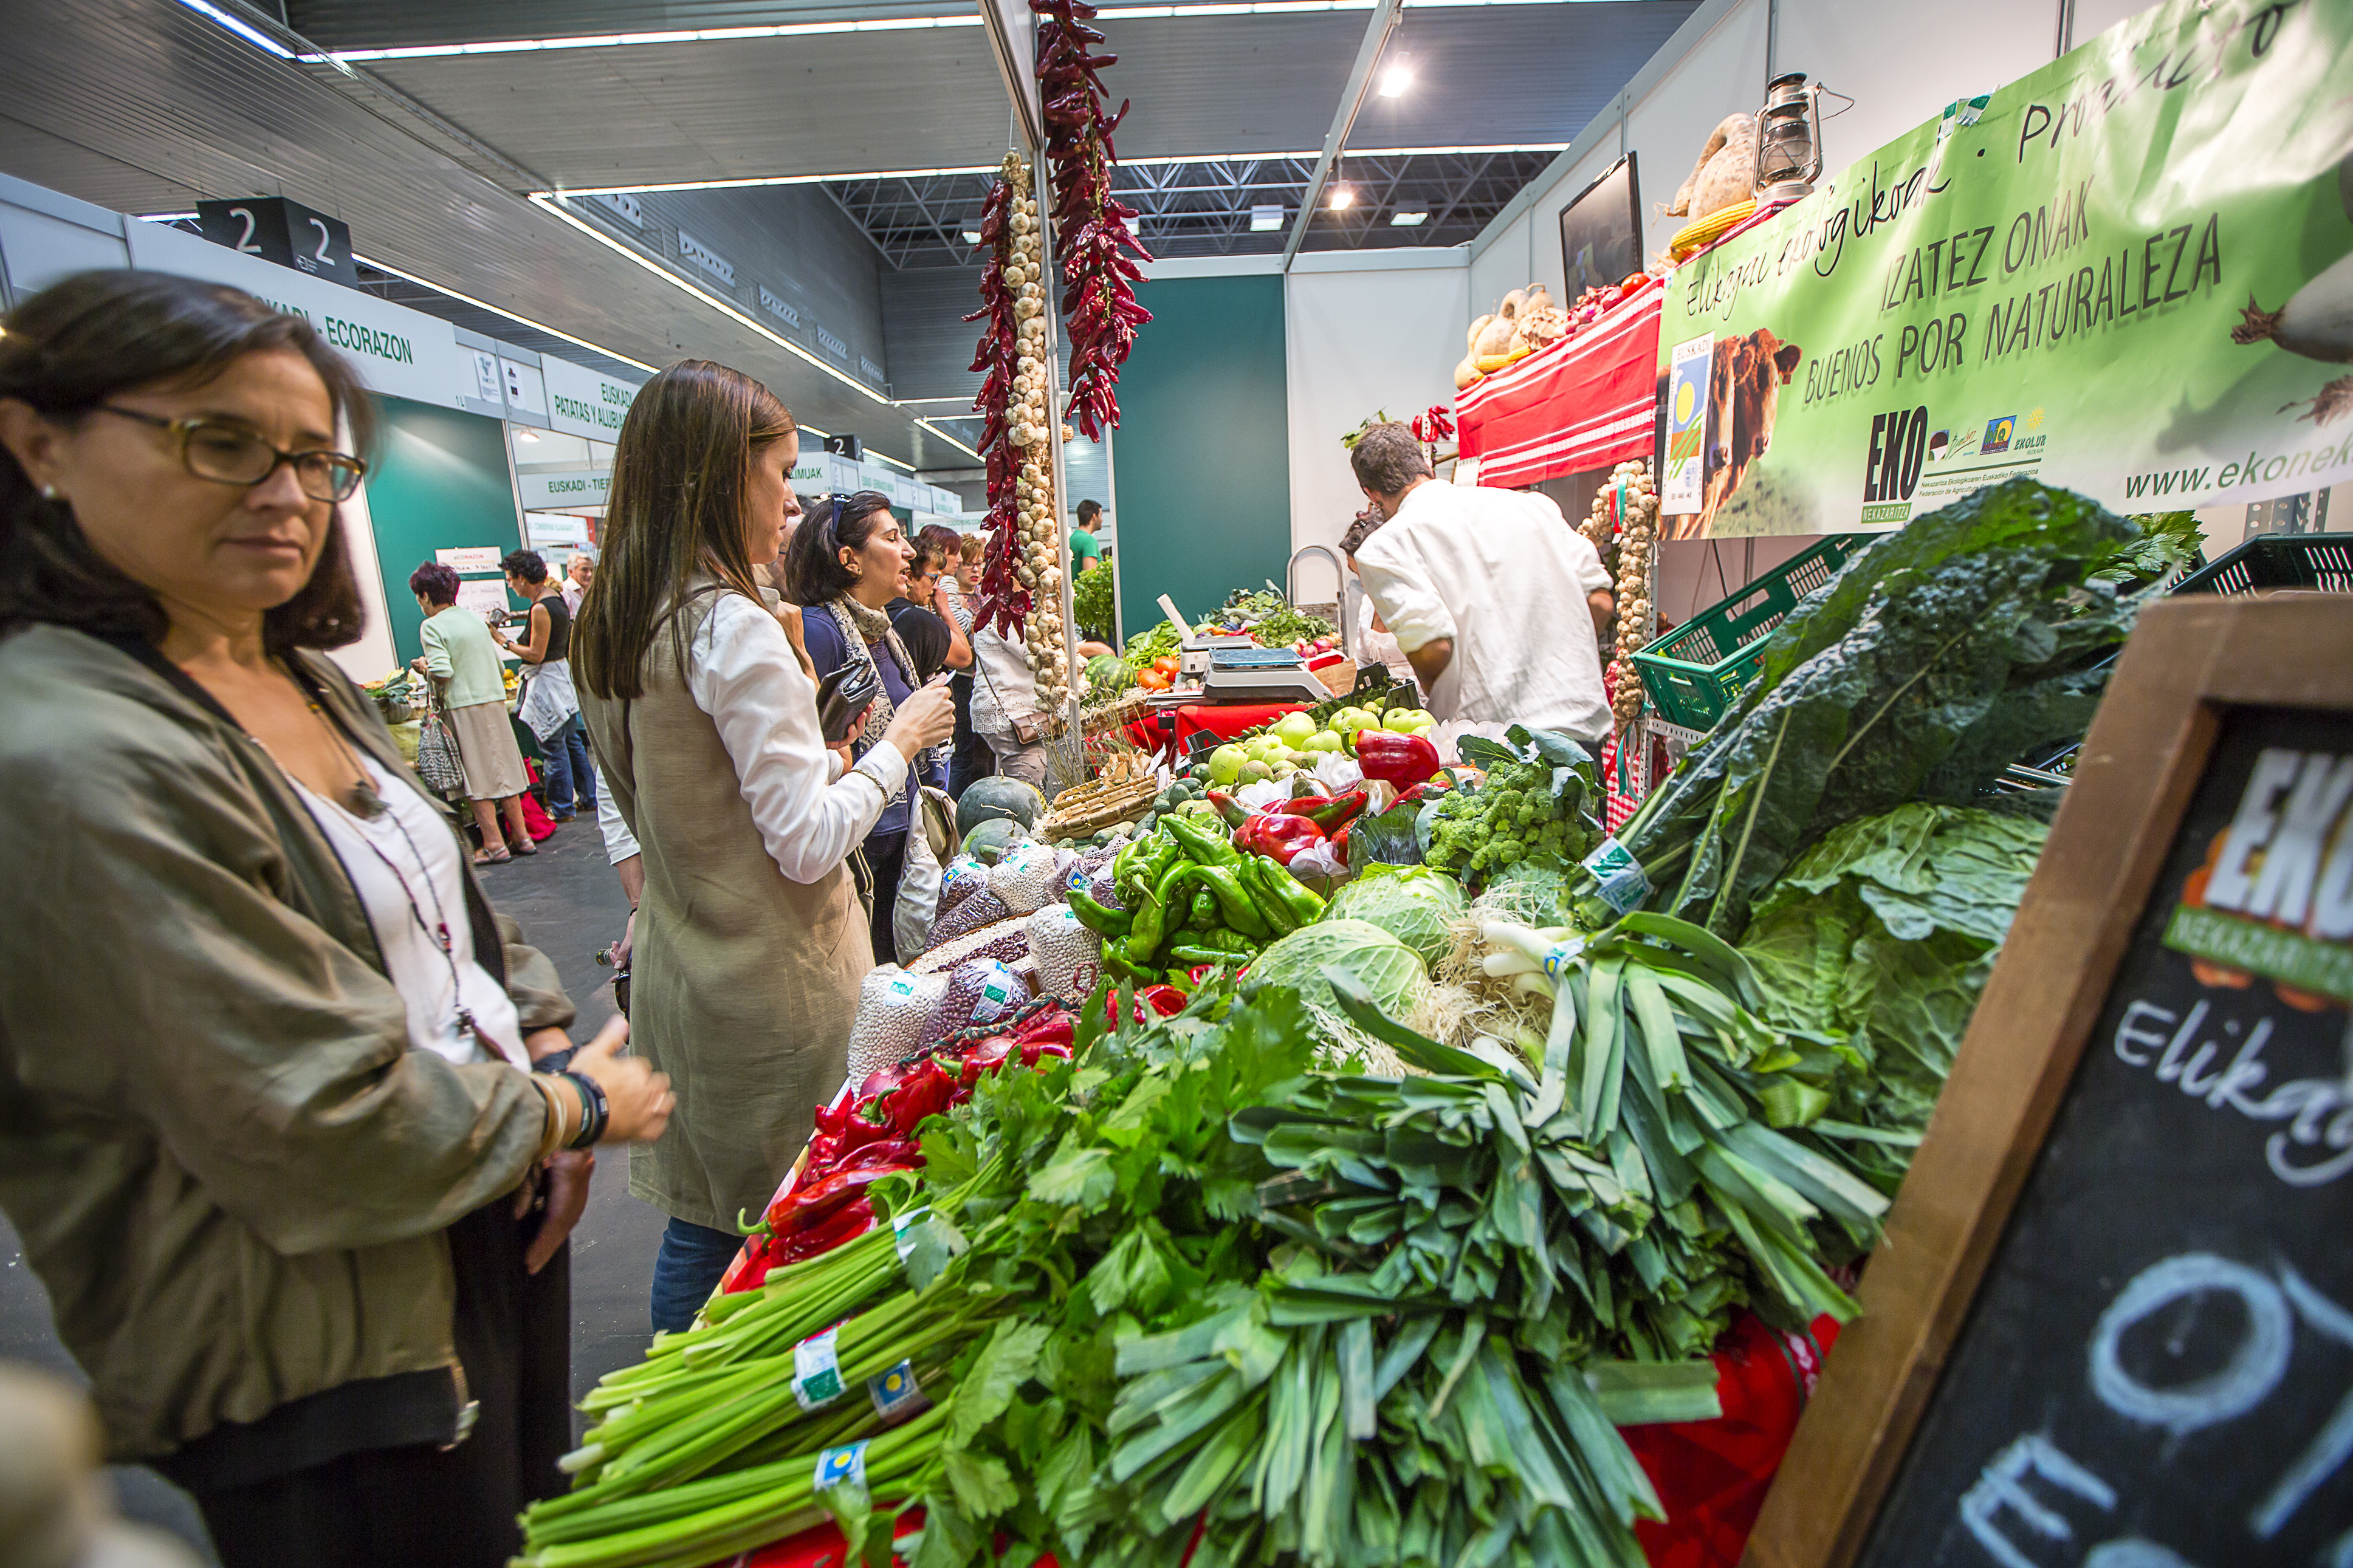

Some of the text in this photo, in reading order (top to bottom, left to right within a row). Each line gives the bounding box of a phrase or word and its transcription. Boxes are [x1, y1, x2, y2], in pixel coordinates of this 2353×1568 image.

[230, 208, 262, 253] 2
[309, 218, 335, 266] 2
[1881, 174, 2095, 312] IZATEZ ONAK
[1805, 212, 2221, 405] BUENOS POR NATURALEZA
[325, 316, 414, 365] ECORAZON
[1677, 338, 1711, 360] EUSKADI
[554, 394, 590, 423] PATATAS
[590, 405, 596, 424] Y
[601, 383, 632, 408] EUSKADI
[834, 438, 845, 455] 2
[1863, 405, 1928, 502] EKO
[2014, 434, 2047, 450] EKOLUR
[548, 479, 585, 493] EUSKADI
[1863, 505, 1909, 521] NEKAZARITZA
